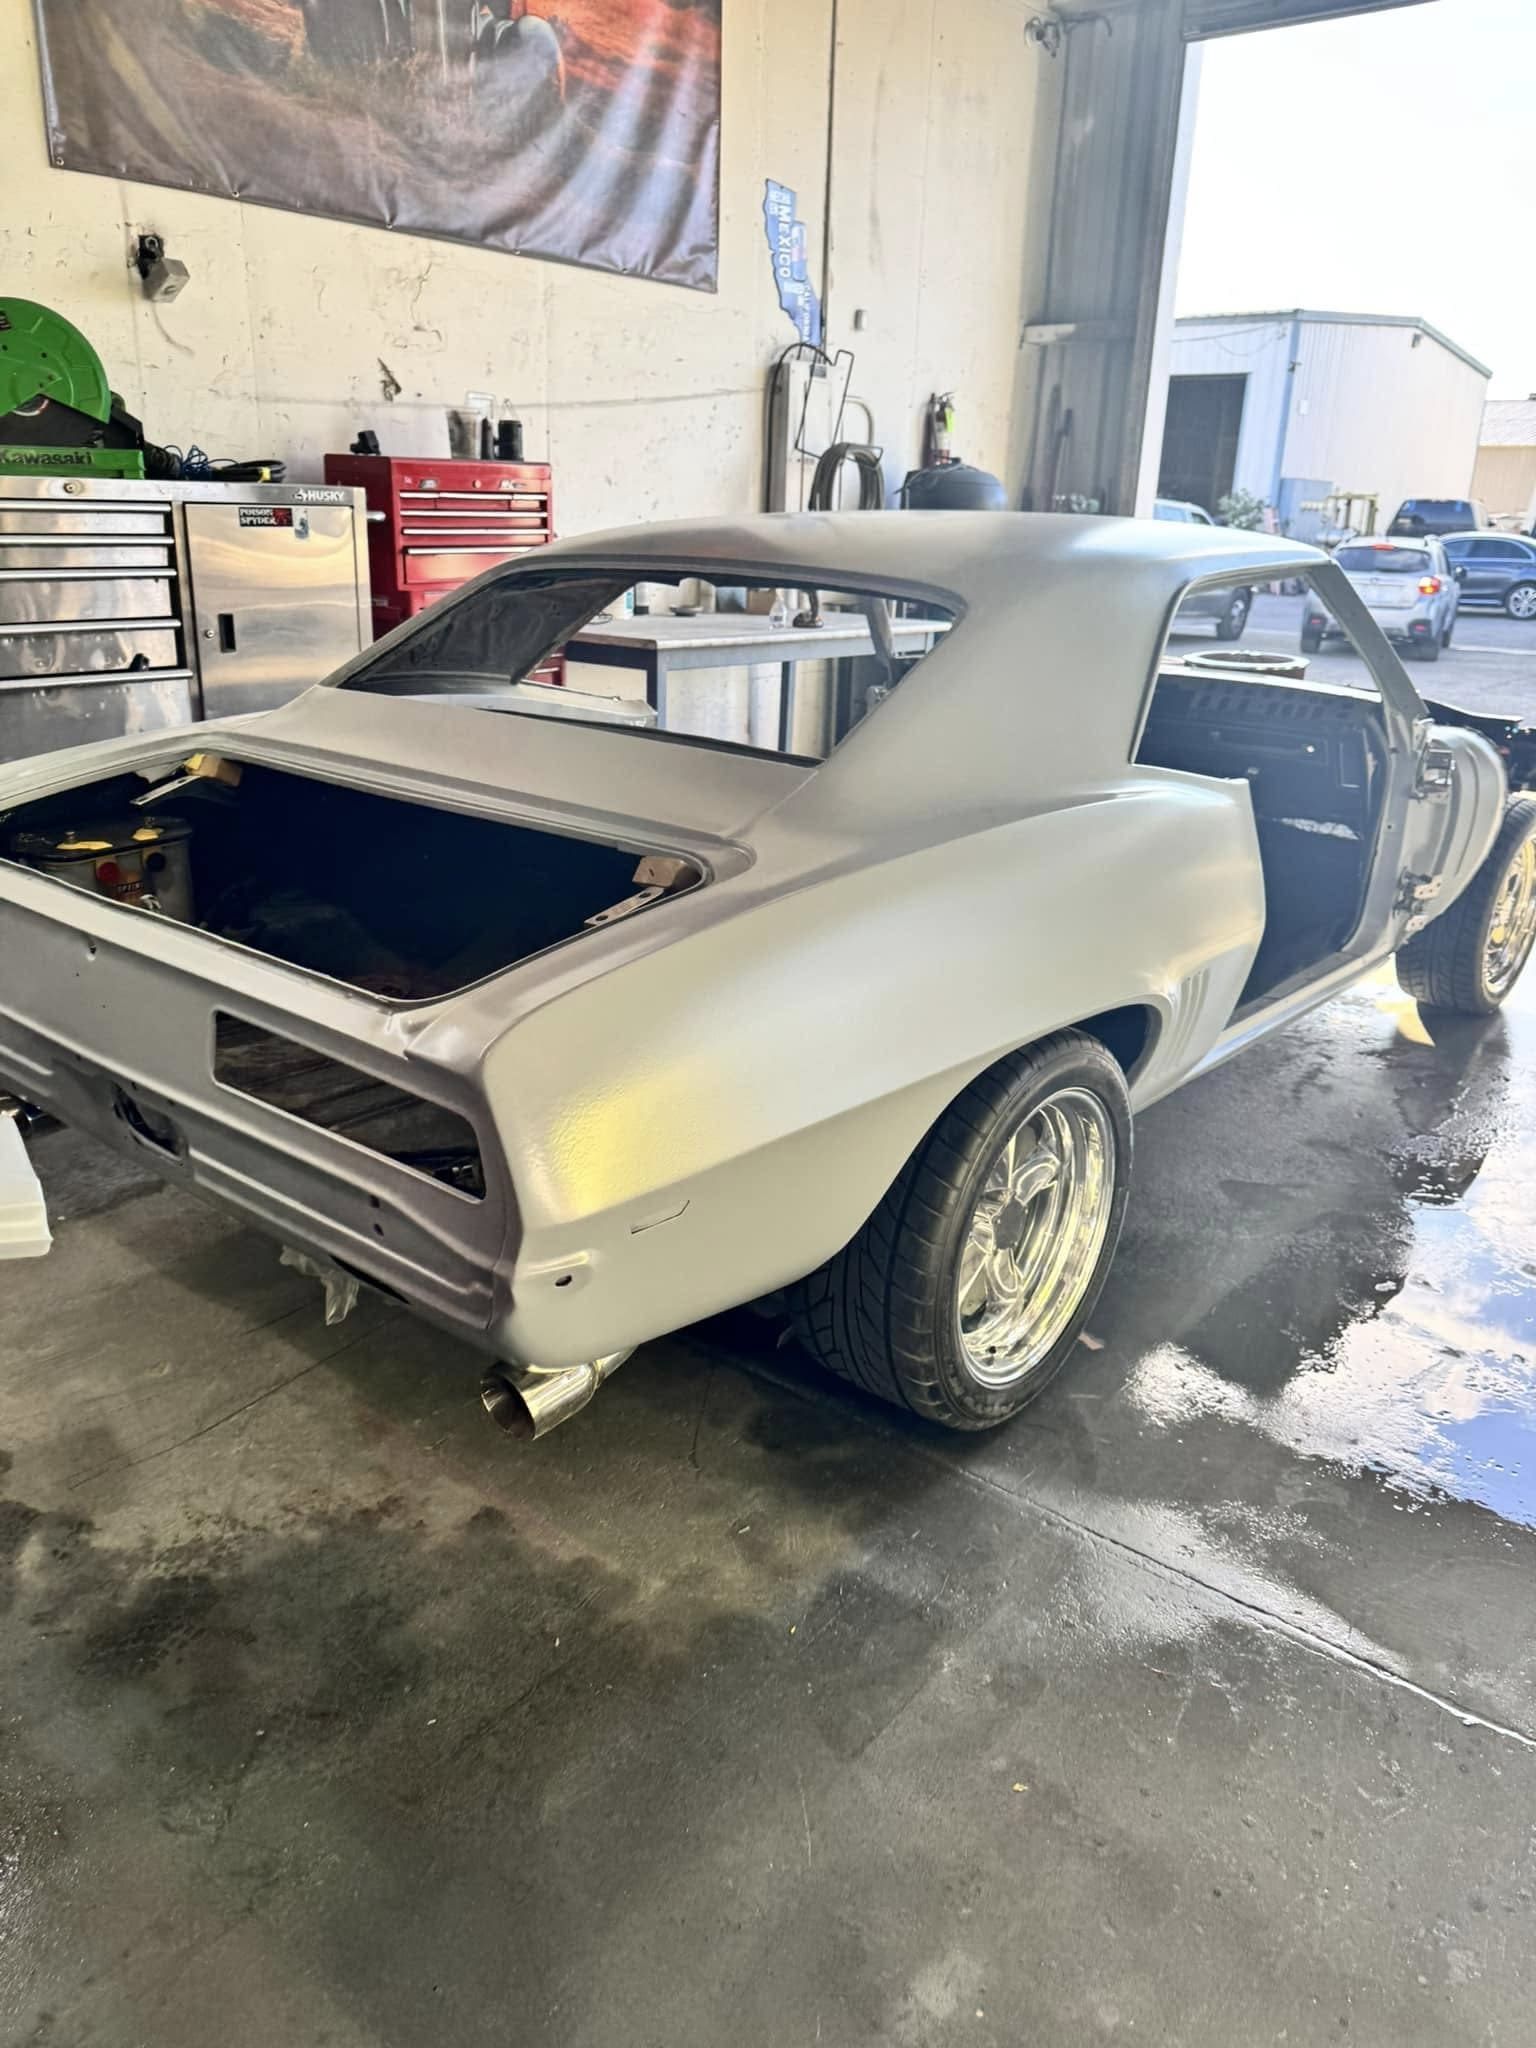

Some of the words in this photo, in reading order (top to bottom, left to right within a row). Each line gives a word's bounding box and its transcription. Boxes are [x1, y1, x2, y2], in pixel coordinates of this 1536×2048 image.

[778, 204, 792, 278] MEXICO
[0, 451, 93, 465] Kawasaki
[307, 489, 345, 501] HUSKY
